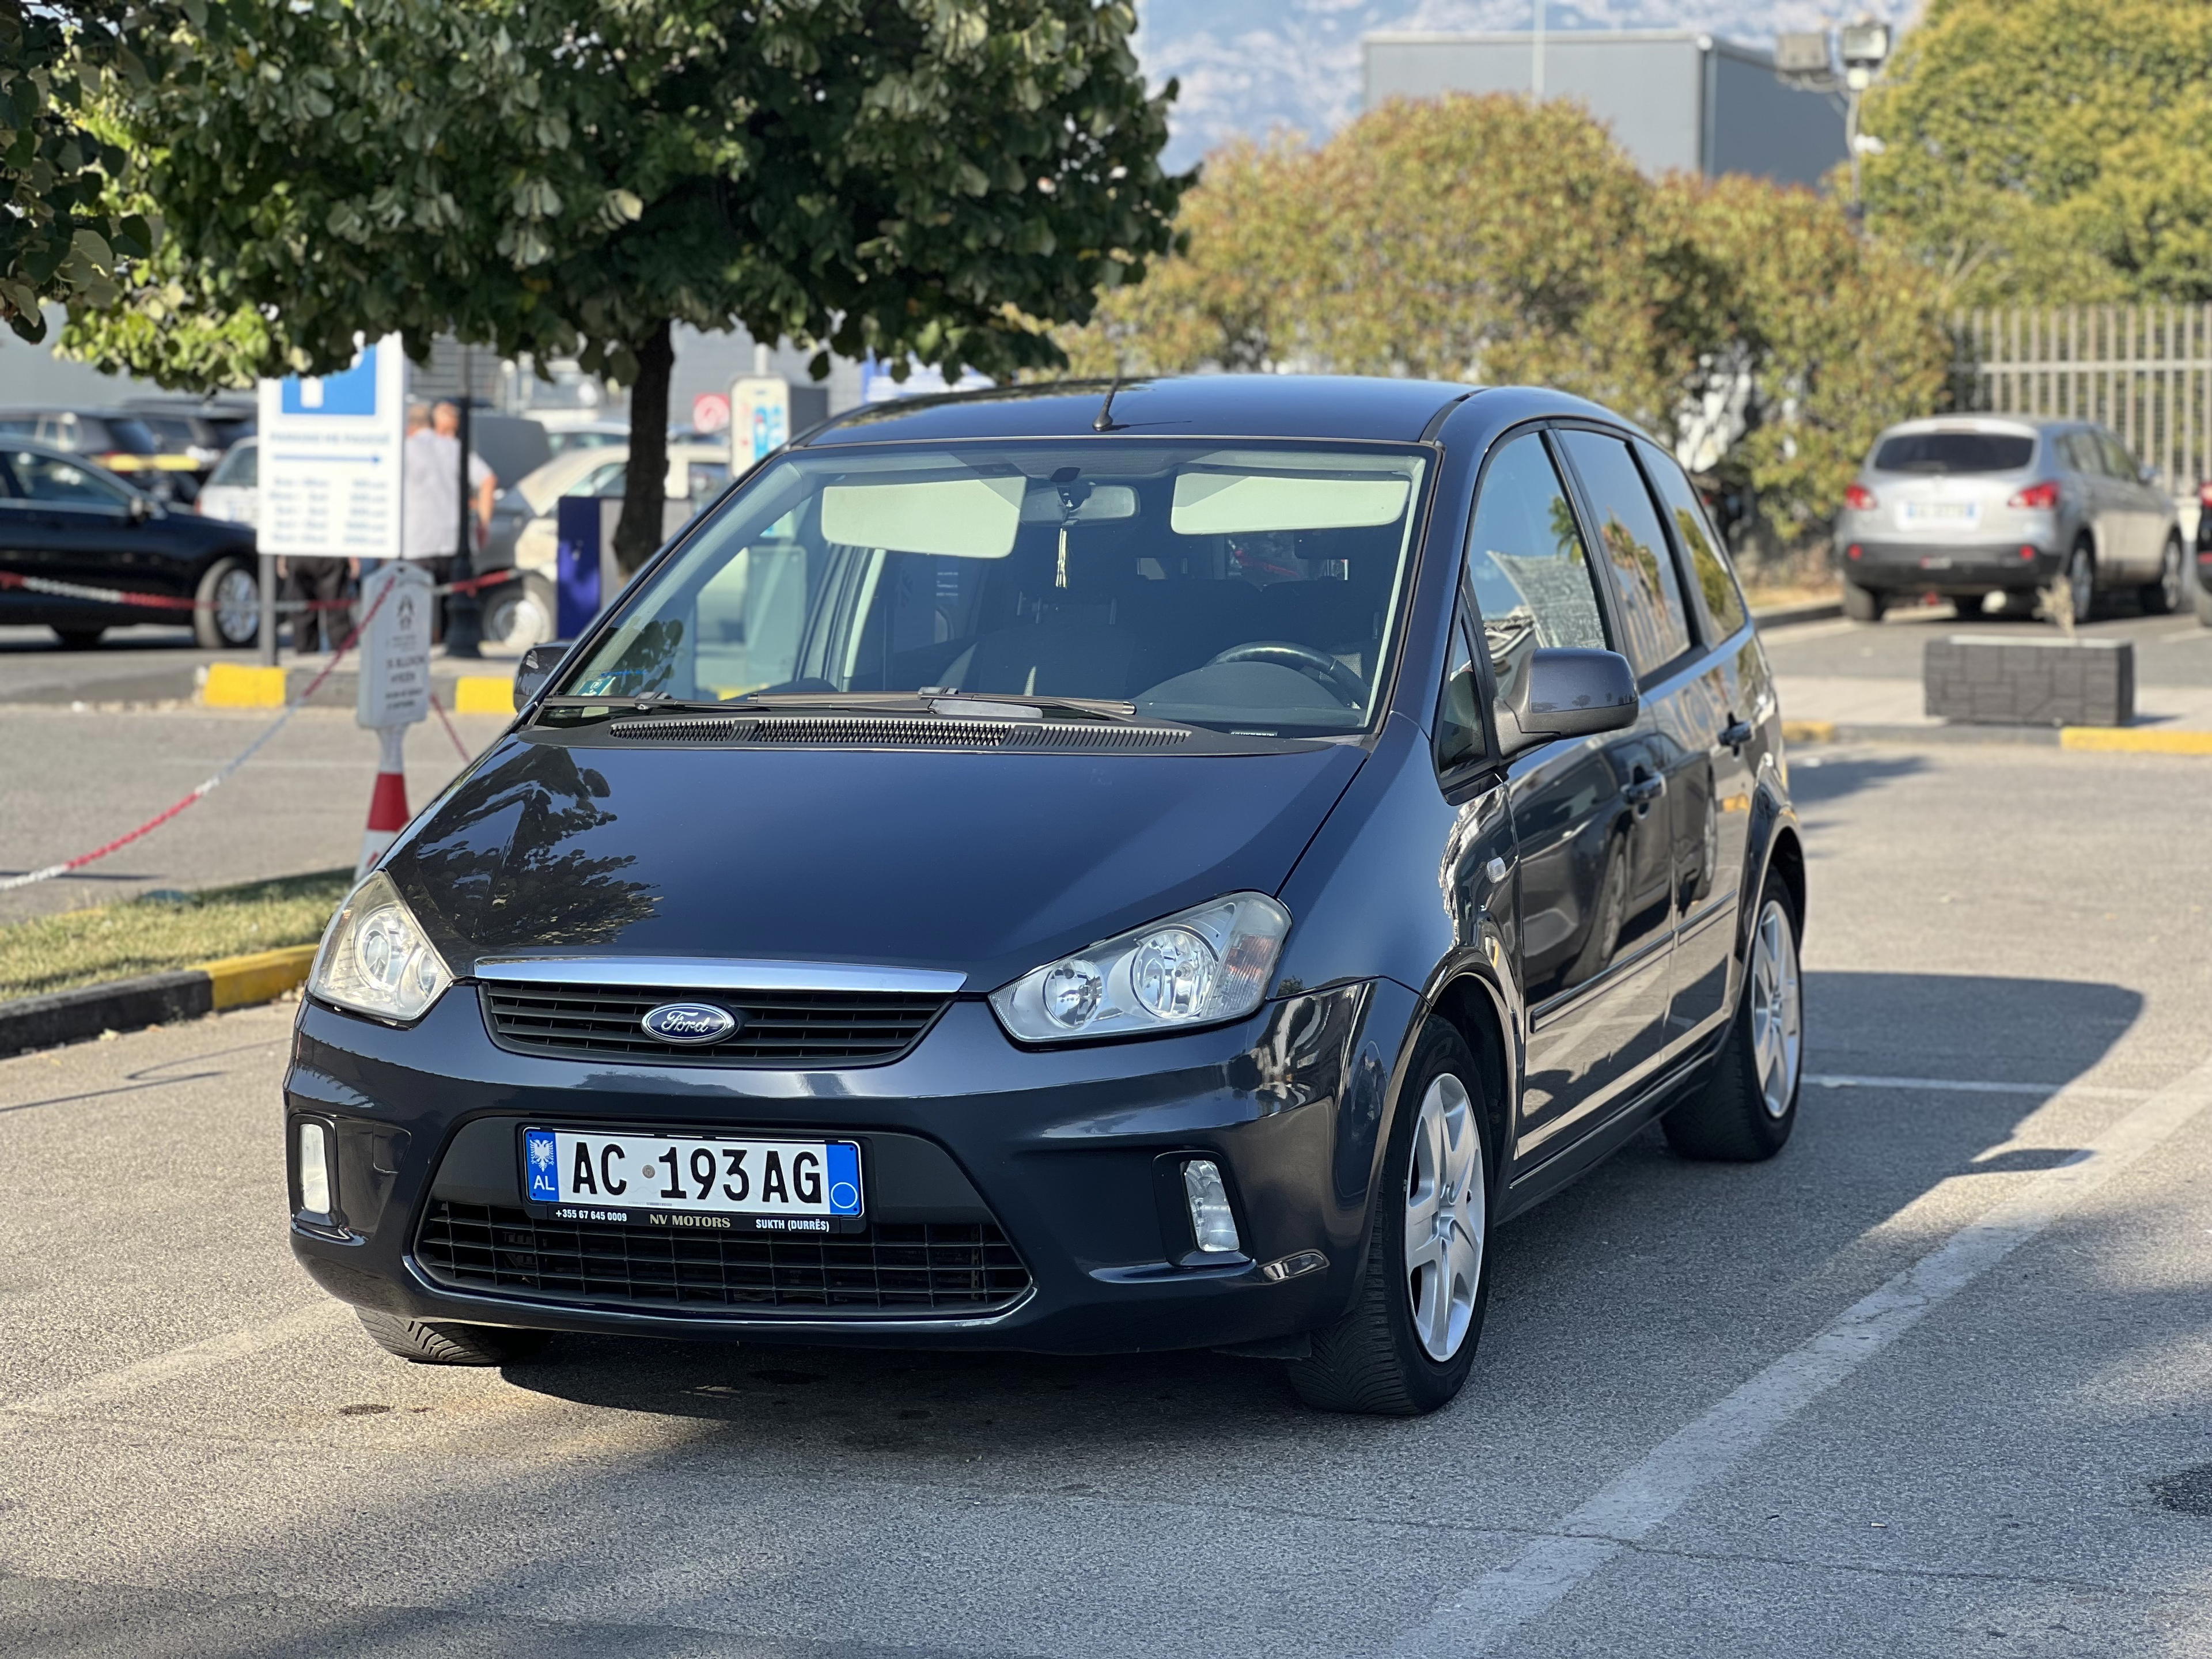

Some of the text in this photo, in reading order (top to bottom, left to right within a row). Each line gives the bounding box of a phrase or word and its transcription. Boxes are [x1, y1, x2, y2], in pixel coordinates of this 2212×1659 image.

[661, 1010, 710, 1032] Ford
[573, 1142, 627, 1195] AC
[533, 1175, 555, 1191] AL
[556, 1209, 627, 1221] +355 67 645 0009
[650, 1214, 730, 1228] NV MOTORS
[756, 1218, 830, 1232] SUKTH (DURRËS)
